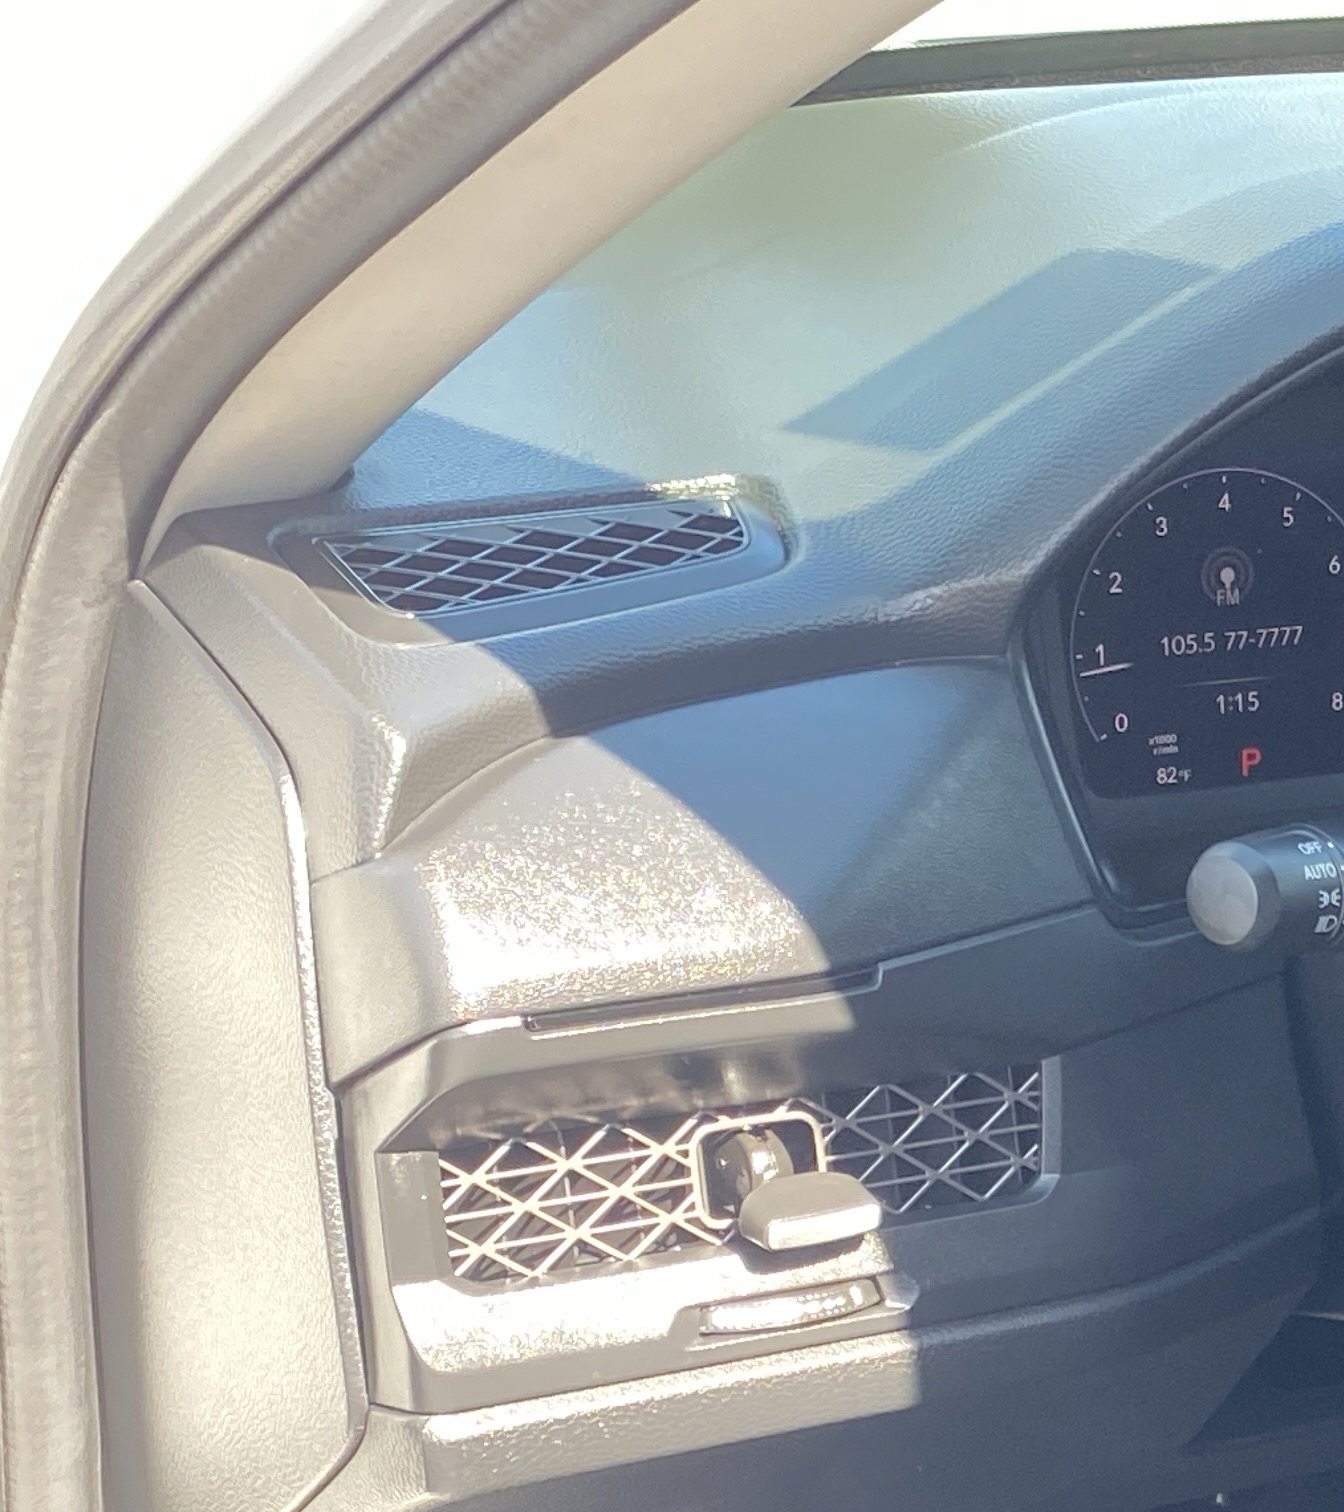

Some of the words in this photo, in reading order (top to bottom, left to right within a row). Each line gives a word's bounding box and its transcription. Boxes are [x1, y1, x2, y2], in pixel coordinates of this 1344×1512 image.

[1218, 493, 1231, 511] 4
[1155, 517, 1168, 536] 3
[1282, 507, 1294, 527] 5
[1329, 555, 1341, 574] 6
[1108, 572, 1123, 593] 2
[1216, 589, 1240, 606] FM
[1160, 631, 1215, 656] 105.5
[1224, 625, 1303, 650] 77-7777
[1095, 644, 1105, 665] 1
[1215, 691, 1260, 714] 1:15
[1331, 692, 1344, 711] 8
[1115, 713, 1128, 733] 0
[1240, 747, 1262, 777] P
[1298, 841, 1322, 854] OFF
[1304, 863, 1336, 880] AUTO
